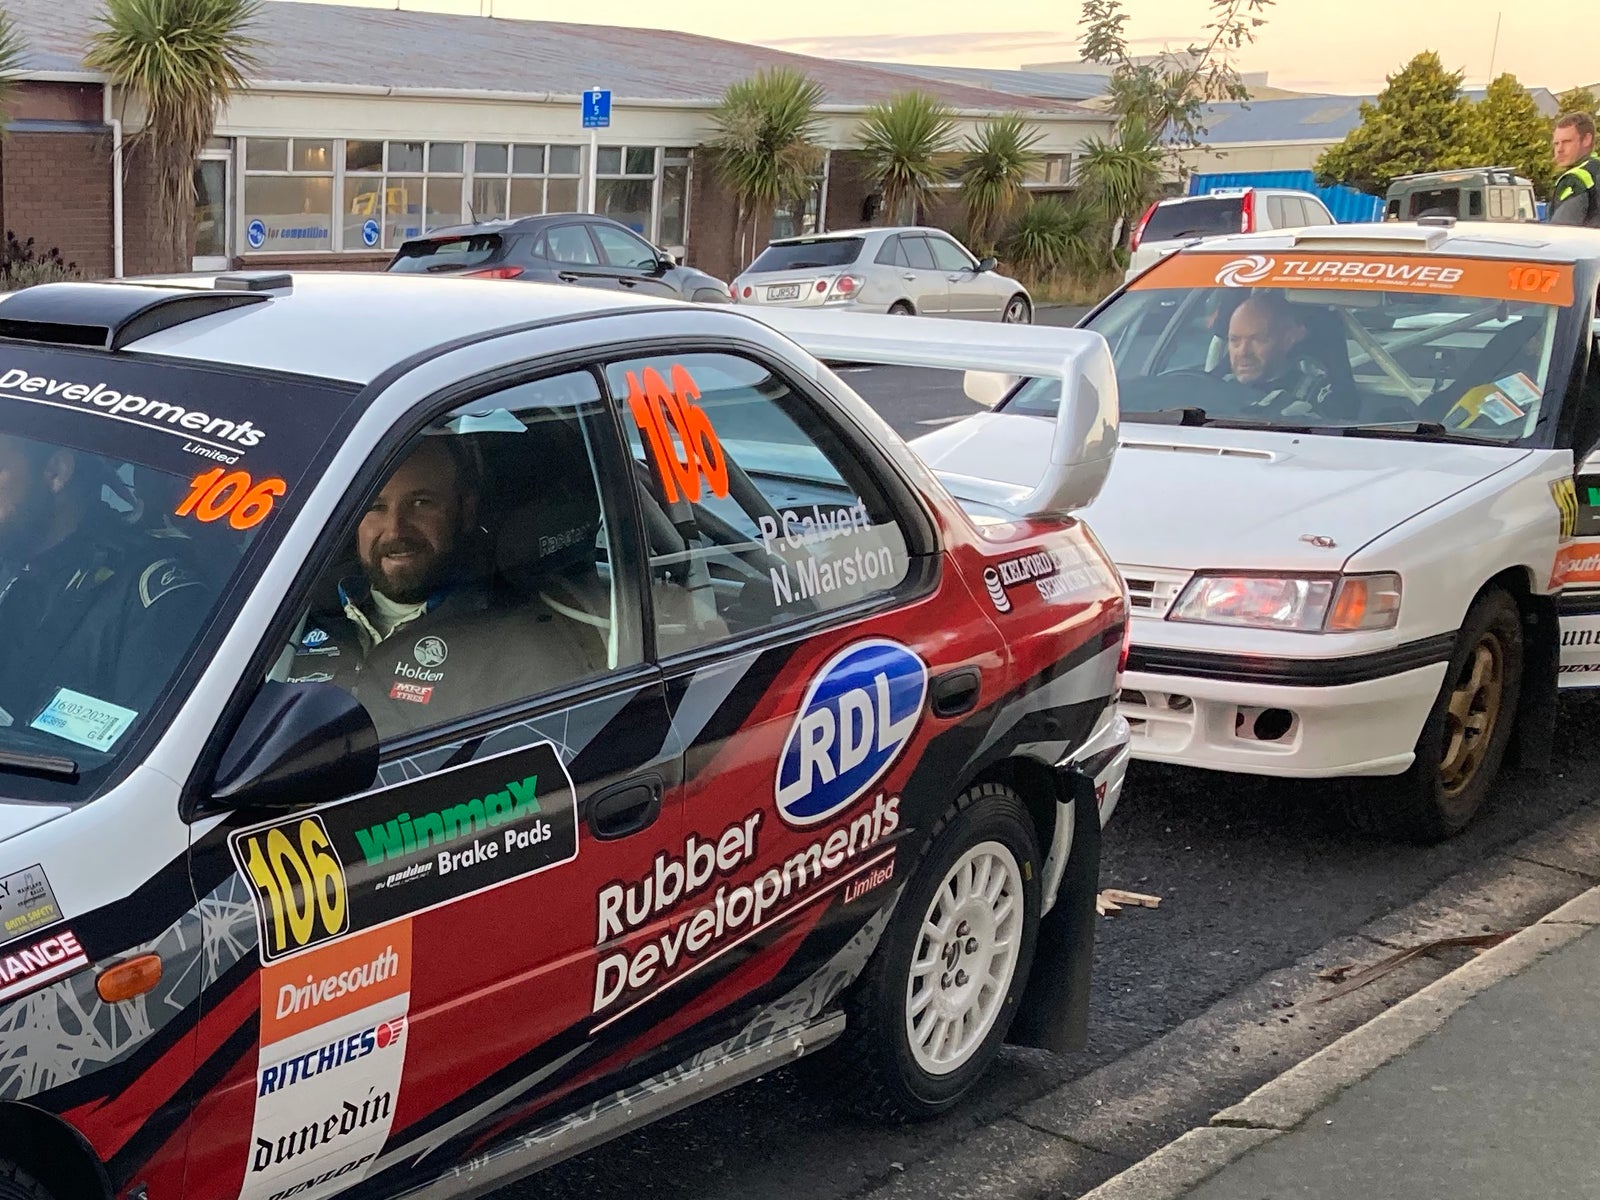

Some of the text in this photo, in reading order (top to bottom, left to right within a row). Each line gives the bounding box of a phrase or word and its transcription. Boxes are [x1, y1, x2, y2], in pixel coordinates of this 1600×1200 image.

[592, 92, 602, 105] P
[1282, 260, 1561, 294] TURBOWEB 107
[182, 441, 240, 466] Limited
[625, 363, 730, 504] 106
[174, 467, 287, 531] 106
[769, 545, 895, 607] N.Marston
[997, 551, 1053, 586] KELFORD
[394, 661, 444, 682] Holden
[396, 682, 434, 695] MRF
[778, 671, 919, 809] RDL
[247, 818, 346, 951] 106
[386, 861, 433, 888] paddon
[437, 839, 499, 876] Brake
[505, 820, 552, 853] Pads
[597, 813, 760, 945] Rubber
[843, 859, 895, 905] Limited
[592, 793, 900, 1014] Developments
[275, 945, 399, 1021] Drivesouth
[257, 1026, 378, 1098] RITCHIES
[251, 1086, 392, 1173] dunedin
